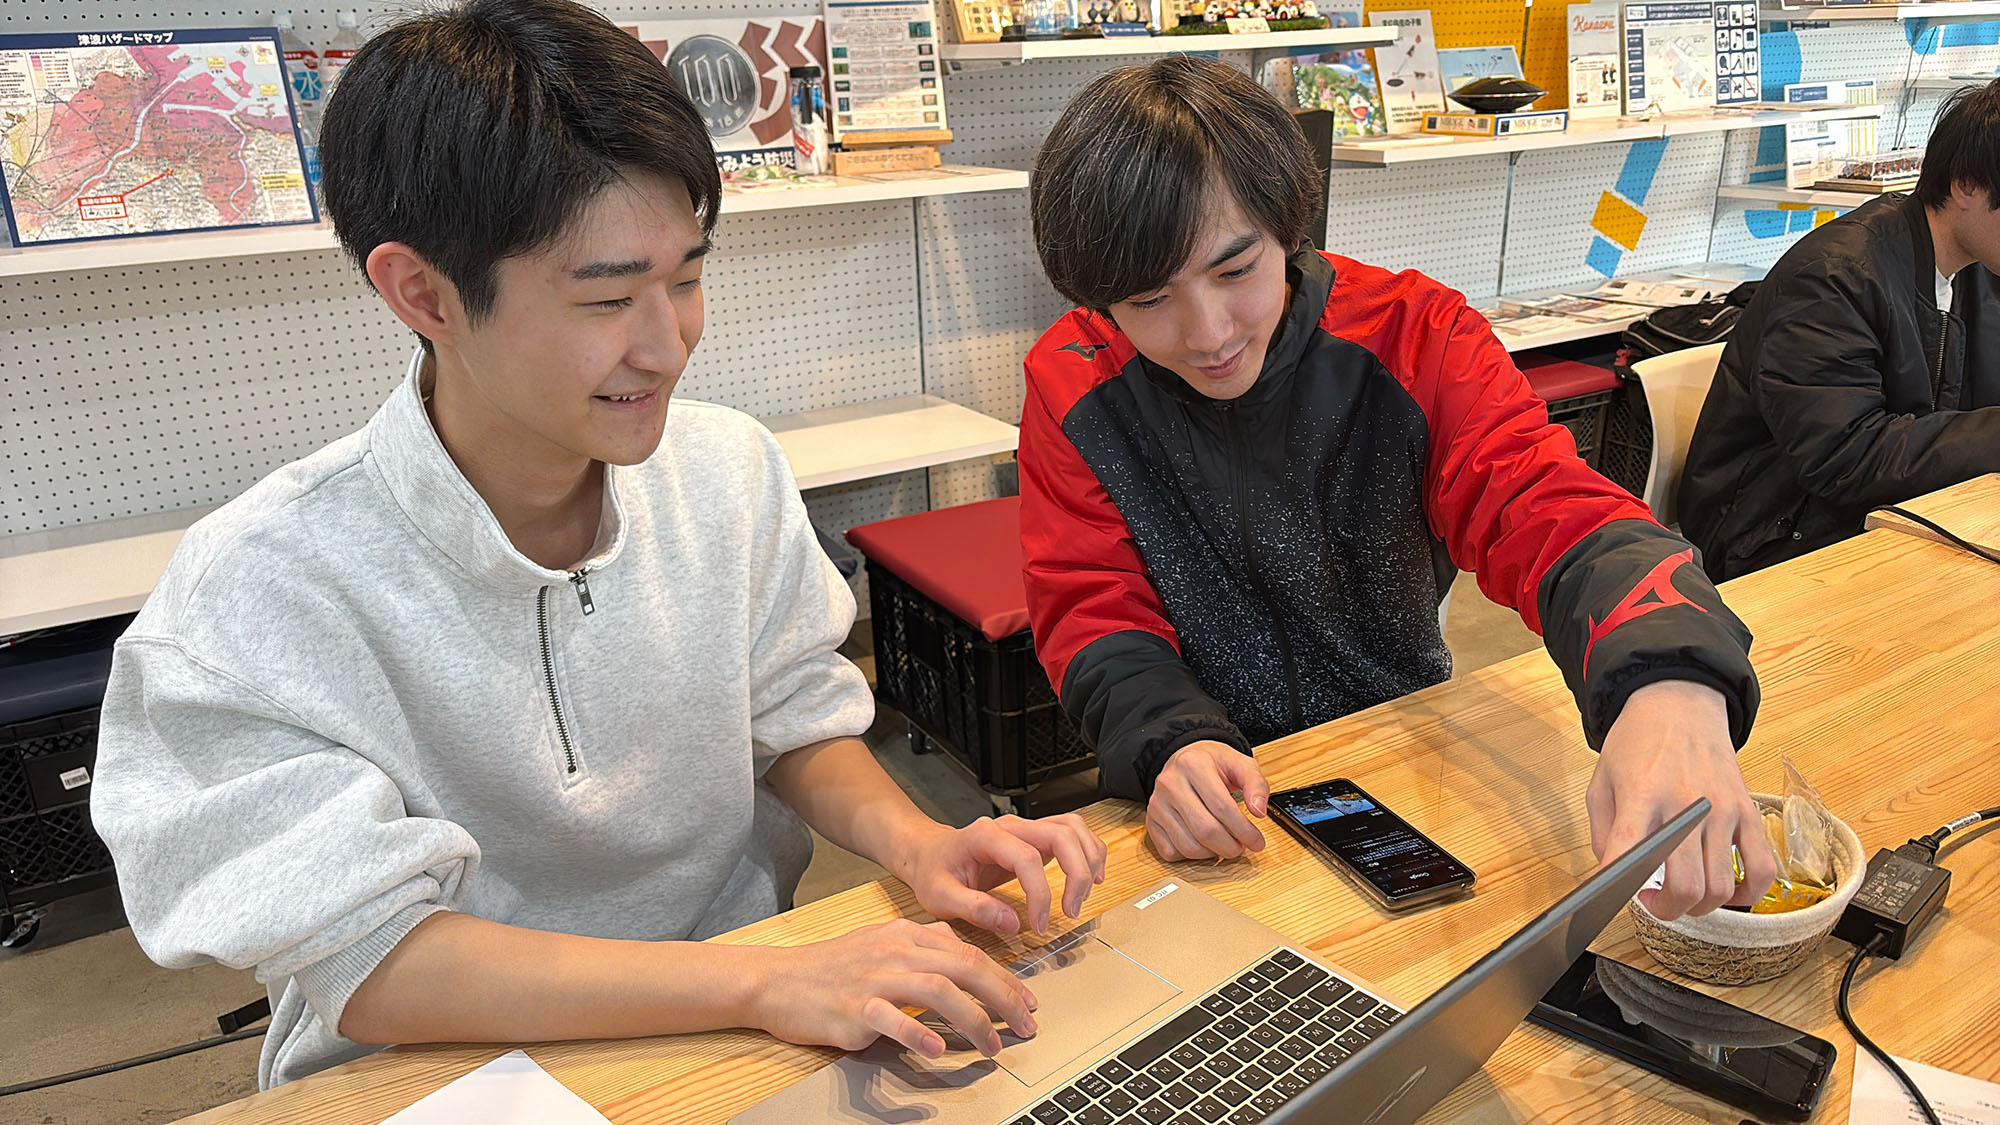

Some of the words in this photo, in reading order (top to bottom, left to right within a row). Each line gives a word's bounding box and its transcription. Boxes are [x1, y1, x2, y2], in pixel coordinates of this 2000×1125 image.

[78, 31, 174, 46] 津波ハザードマップ
[296, 72, 321, 99] 水
[678, 53, 737, 107] 100
[717, 150, 795, 172] みよう防災
[1065, 1093, 1077, 1103] ALT
[1039, 1106, 1058, 1117] CTRL
